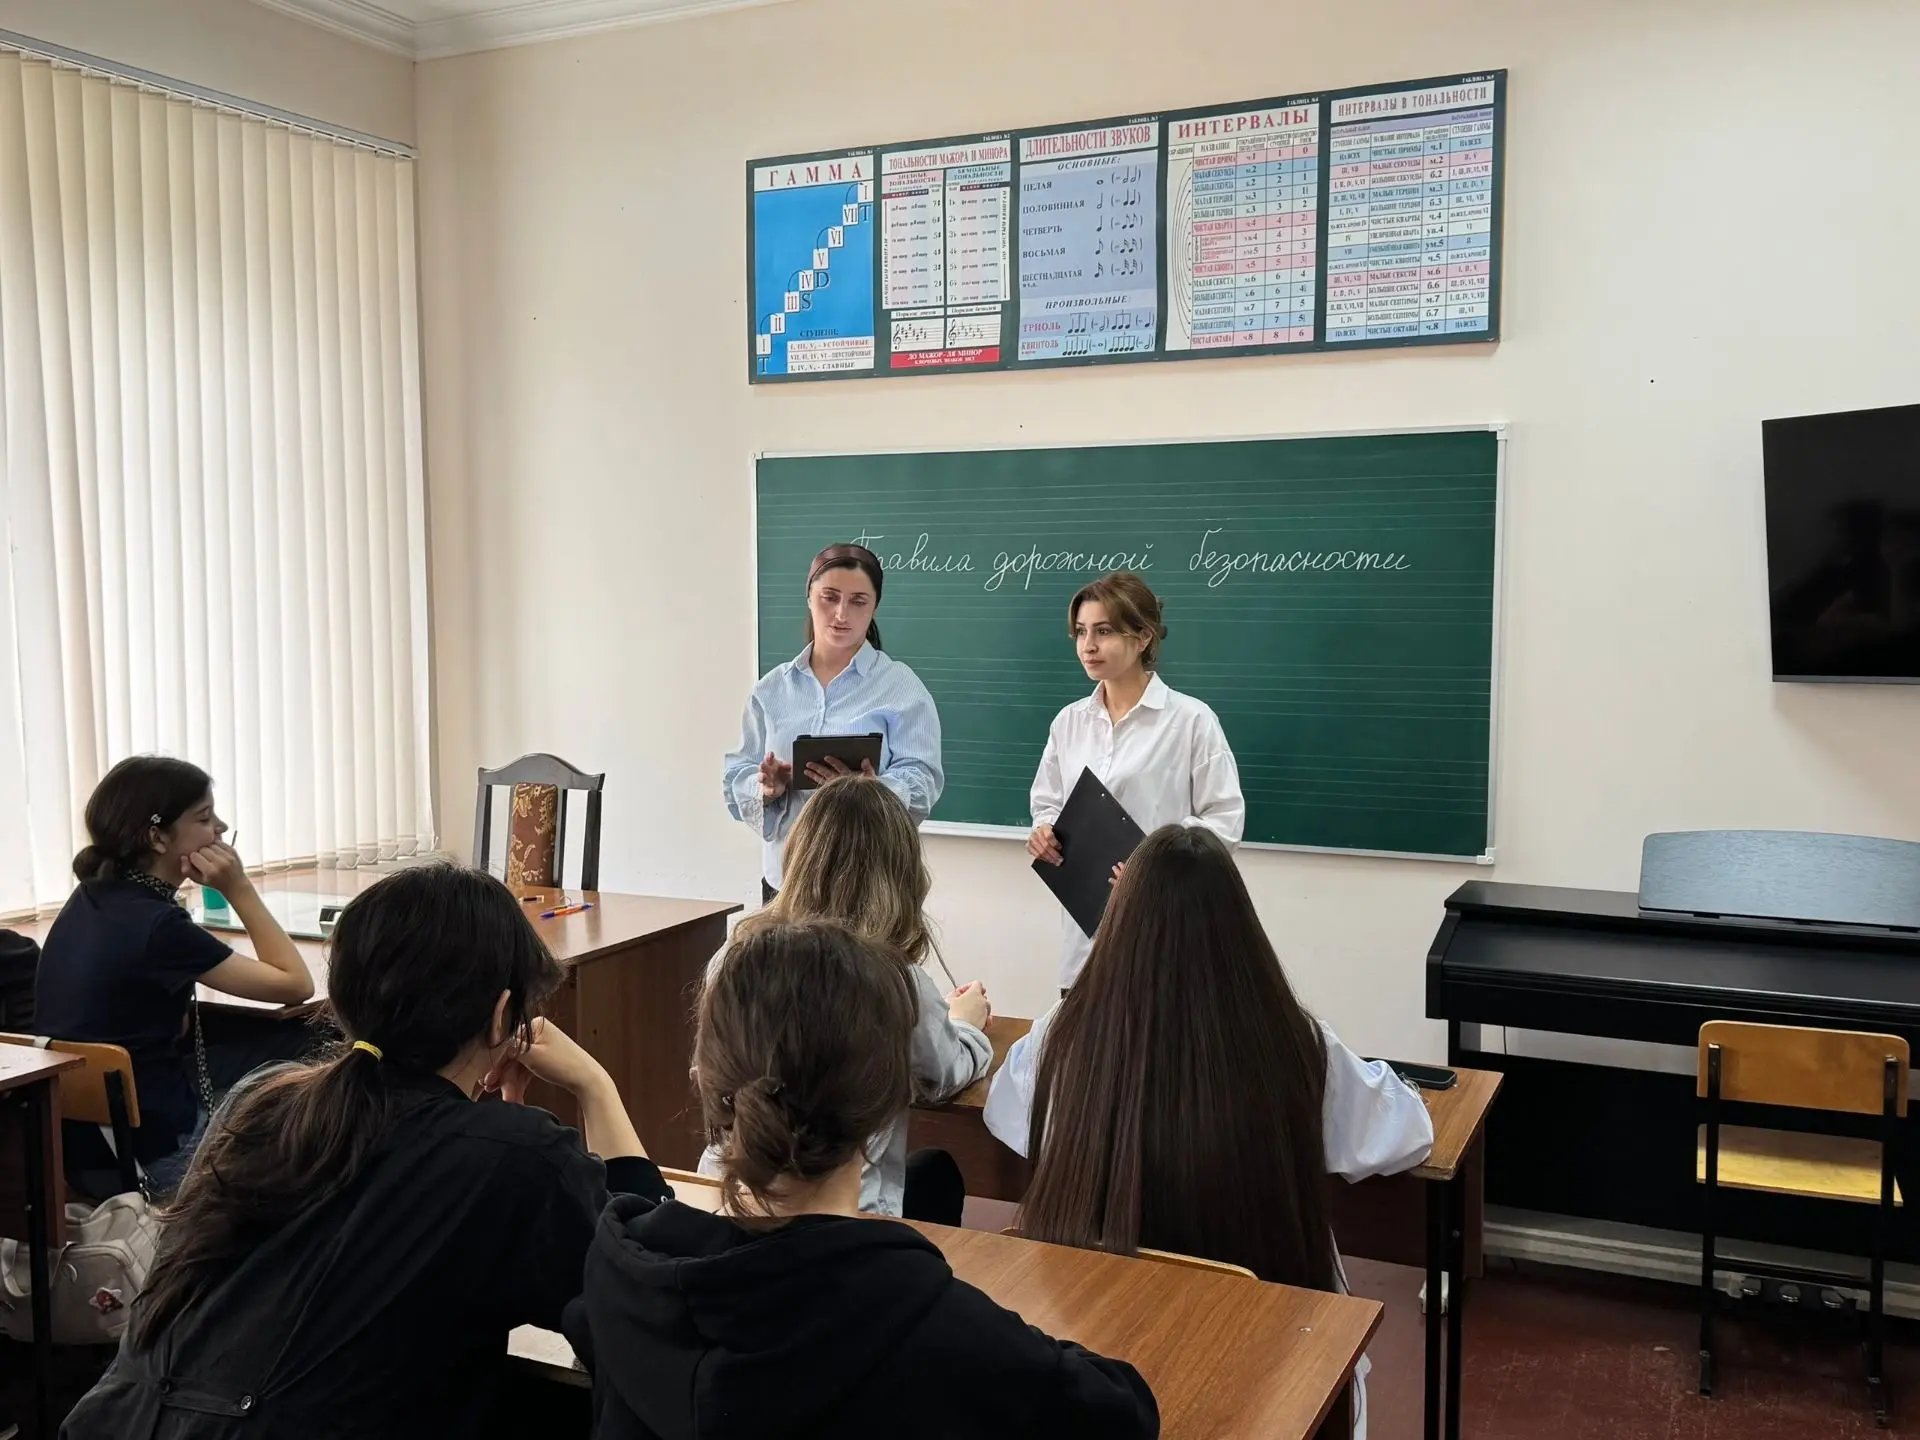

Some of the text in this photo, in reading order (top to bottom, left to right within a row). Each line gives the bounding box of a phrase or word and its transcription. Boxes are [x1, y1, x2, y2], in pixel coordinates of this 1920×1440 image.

[1338, 87, 1486, 117] ИНТЕРВАЛЫ В ТОНАЛЬНОСТИ
[1177, 109, 1309, 139] ИНТЕРВАЛЫ
[1026, 125, 1151, 159] ДЛИТЕЛЬНОСТИ ЗВУКОВ
[1201, 142, 1230, 153] НАЗВАНИЕ
[1430, 142, 1442, 151] ч.1
[889, 147, 1008, 170] ТОНАЛЬНОСТИ МАЖОРА И МИНОРА
[1057, 156, 1121, 171] ОСНОВНЫЕ:
[1430, 155, 1443, 164] м.2
[1372, 162, 1393, 170] МАЛЫЕ
[769, 162, 862, 187] ГАММА
[954, 171, 1004, 180] ТОНАЛЬНОСТИ
[1430, 170, 1442, 179] б.2
[889, 177, 936, 187] ТОНАЛЬНОСТИ
[1023, 181, 1053, 192] ЦЕЛАЯ
[1429, 183, 1443, 192] м.3
[1372, 189, 1394, 198] МАЛЫЕ
[1022, 200, 1085, 215] ПОЛОВИННАЯ
[1429, 197, 1442, 207] б.3
[844, 208, 857, 223] VII
[1395, 214, 1421, 223] КВАРТЫ
[1428, 211, 1442, 220] ч.4
[1022, 225, 1063, 236] ЧЕТВЕРТЬ
[830, 230, 841, 245] VI
[1425, 239, 1444, 250] ум.5
[1022, 247, 1066, 259] ВОСЬМАЯ
[1427, 253, 1441, 262] ч.5
[817, 252, 825, 267] V
[1022, 269, 1083, 282] ШЕСТНАДЦАТАЯ
[1370, 270, 1417, 281] МАЛЫЕ СЕКСТЫ
[1427, 267, 1441, 276] м.6
[801, 274, 812, 289] IV
[816, 271, 830, 288] D
[1396, 284, 1419, 292] СЕКСТЫ
[1427, 281, 1440, 290] б.6
[787, 296, 798, 311] III
[801, 293, 811, 310] S
[1426, 295, 1440, 303] м.7
[1426, 308, 1439, 317] б.7
[775, 317, 782, 332] II
[1024, 322, 1061, 332] ТРИОЛЬ
[1393, 324, 1418, 333] ОКТАВЫ
[1425, 322, 1439, 331] ч.8
[823, 340, 869, 349] УСТОЙЧИВЫЕ
[1021, 340, 1059, 350] КВИНТОЛЬ
[907, 353, 917, 361] ДО
[958, 349, 983, 357] МИНОР
[822, 362, 855, 370] ГЛАВНЫЕ
[984, 544, 1154, 592] дорожной
[1189, 527, 1412, 588] безопасности
